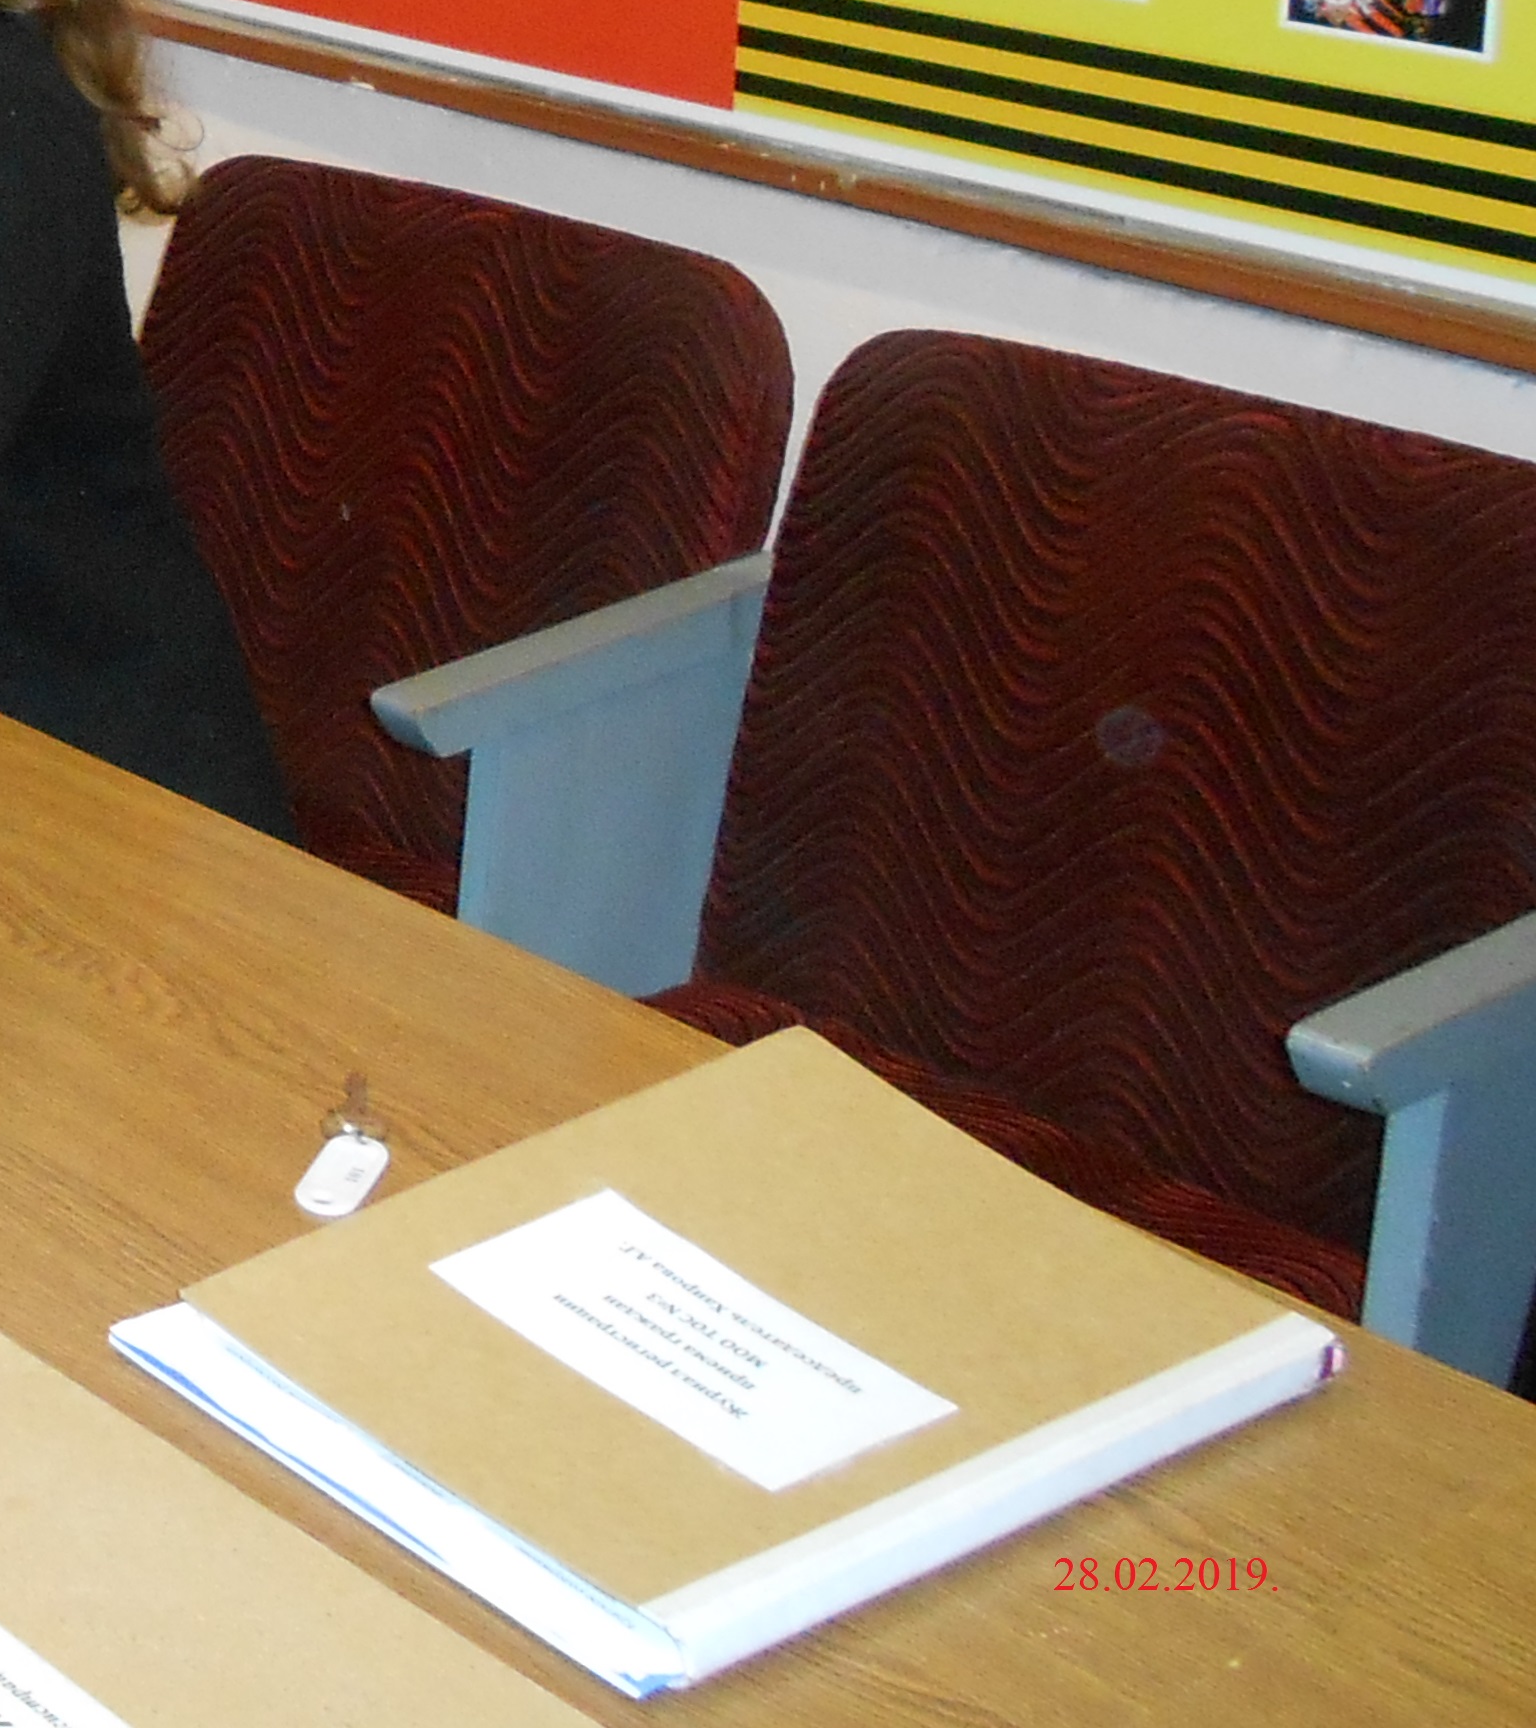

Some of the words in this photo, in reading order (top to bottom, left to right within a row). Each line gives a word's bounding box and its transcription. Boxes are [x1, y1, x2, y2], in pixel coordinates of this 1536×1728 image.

[553, 1295, 673, 1368] регистрации
[604, 1296, 682, 1344] граждан
[680, 1316, 717, 1338] ТОС
[684, 1345, 755, 1389] приема
[720, 1339, 766, 1368] МОО
[731, 1312, 862, 1394] председатель
[671, 1369, 748, 1418] Журнал
